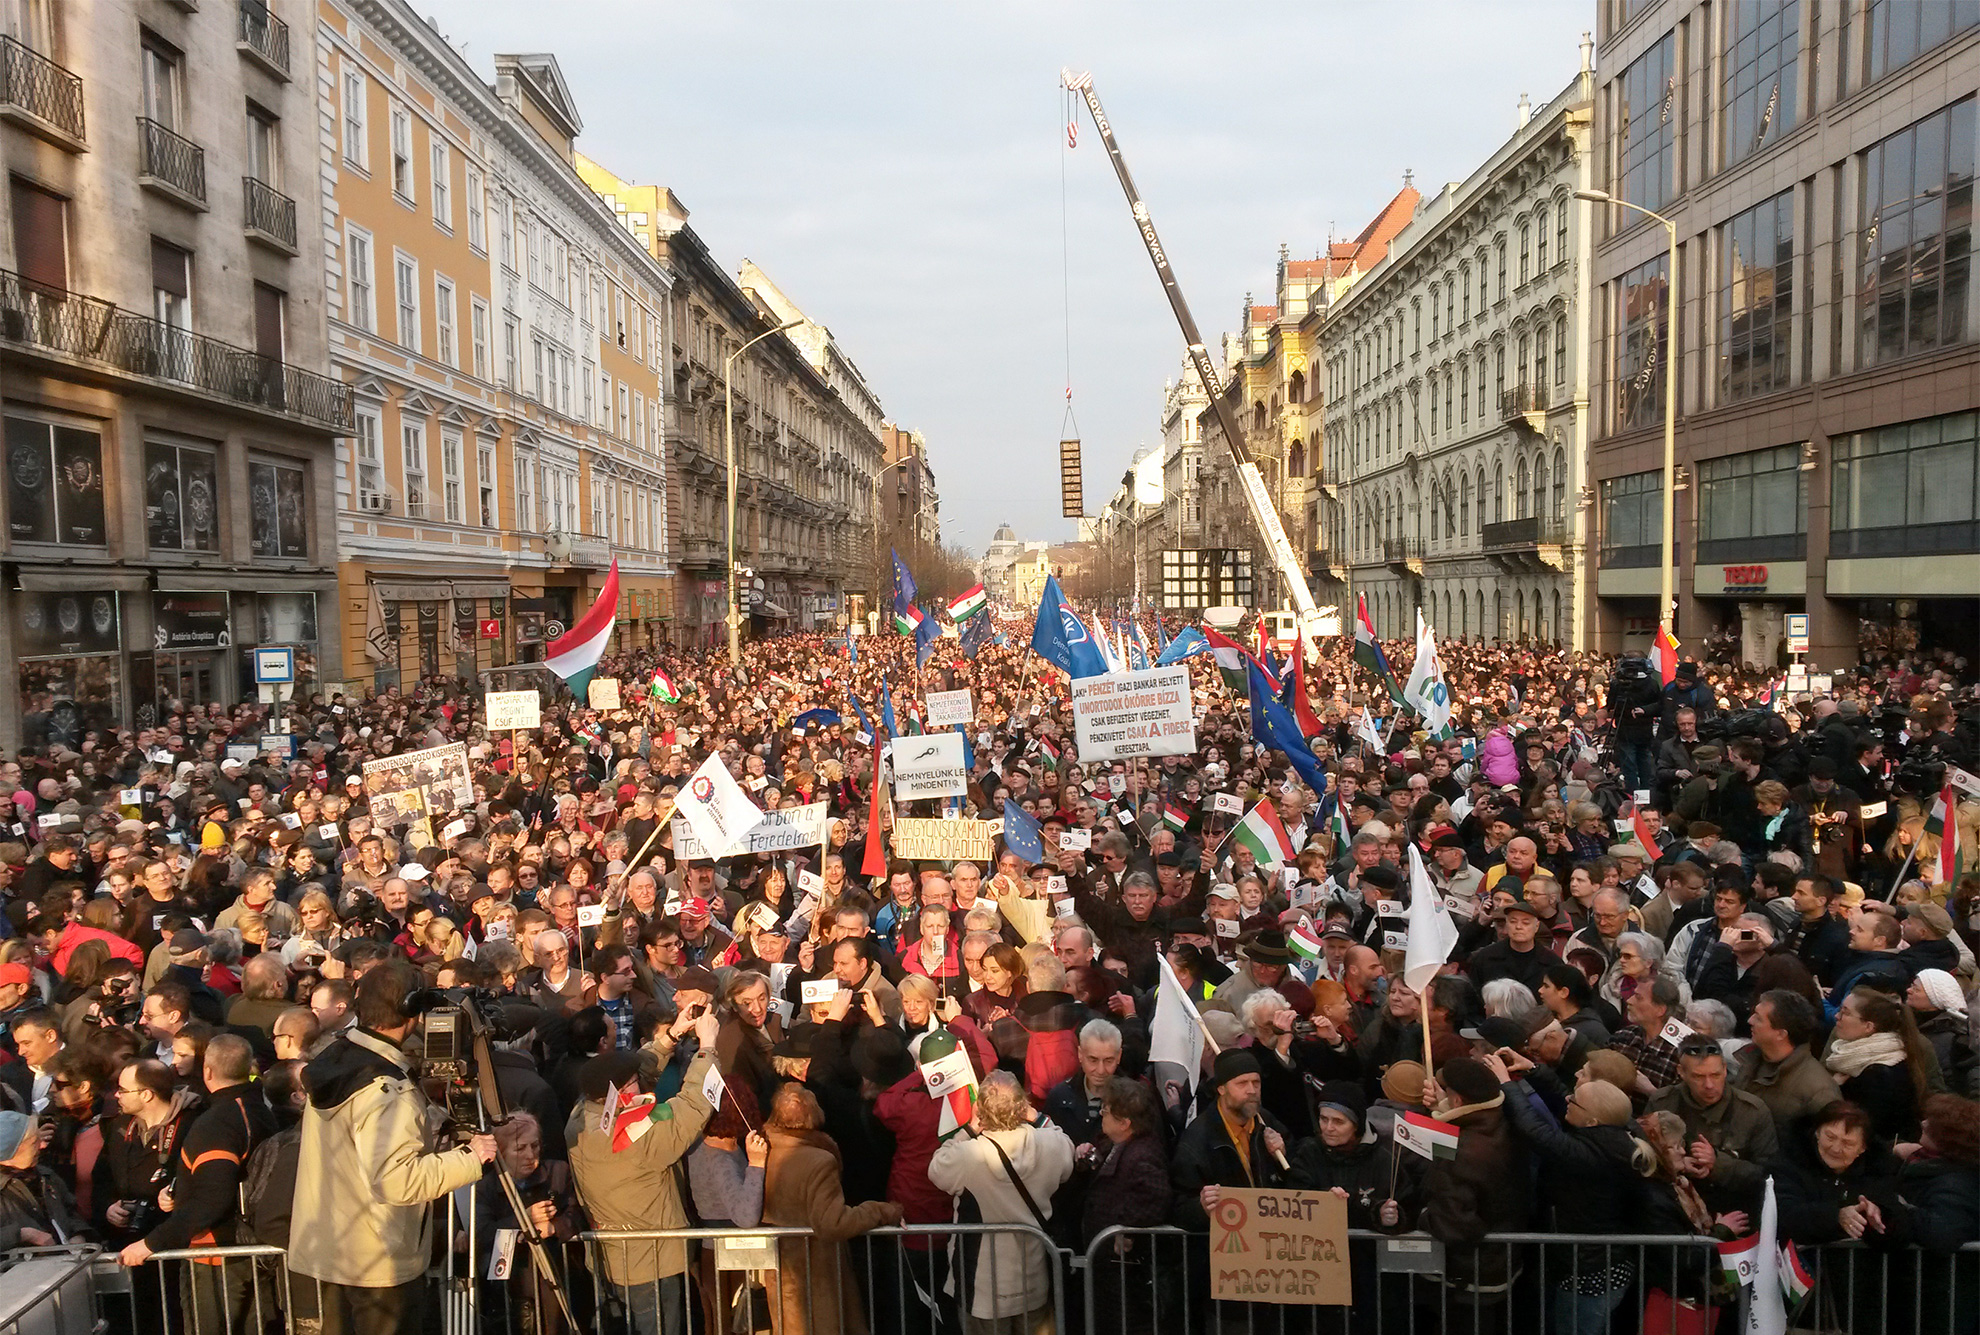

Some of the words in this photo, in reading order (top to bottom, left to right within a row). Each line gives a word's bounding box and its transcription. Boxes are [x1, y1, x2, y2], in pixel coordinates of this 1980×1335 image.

[1723, 565, 1768, 584] TESCO
[1117, 682, 1132, 693] IGAZI
[1133, 678, 1157, 691] BANKÁR
[1158, 675, 1184, 688] HELYETT
[1079, 697, 1123, 715] UNORTODOX
[1157, 689, 1181, 705] BÍZZA
[500, 706, 525, 716] MEGINT
[516, 716, 534, 727] LETT
[1091, 717, 1106, 727] CSAK
[1106, 712, 1139, 726] BEFIZETÉST
[1089, 730, 1126, 744] PÉNZKIVÉTET
[1126, 722, 1148, 739] CSAK
[1148, 722, 1162, 738] A
[1162, 720, 1191, 736] FIDESZ
[1114, 742, 1152, 755] KERESZTAPA.
[915, 768, 953, 780] NYELÜNK
[954, 768, 964, 776] LE
